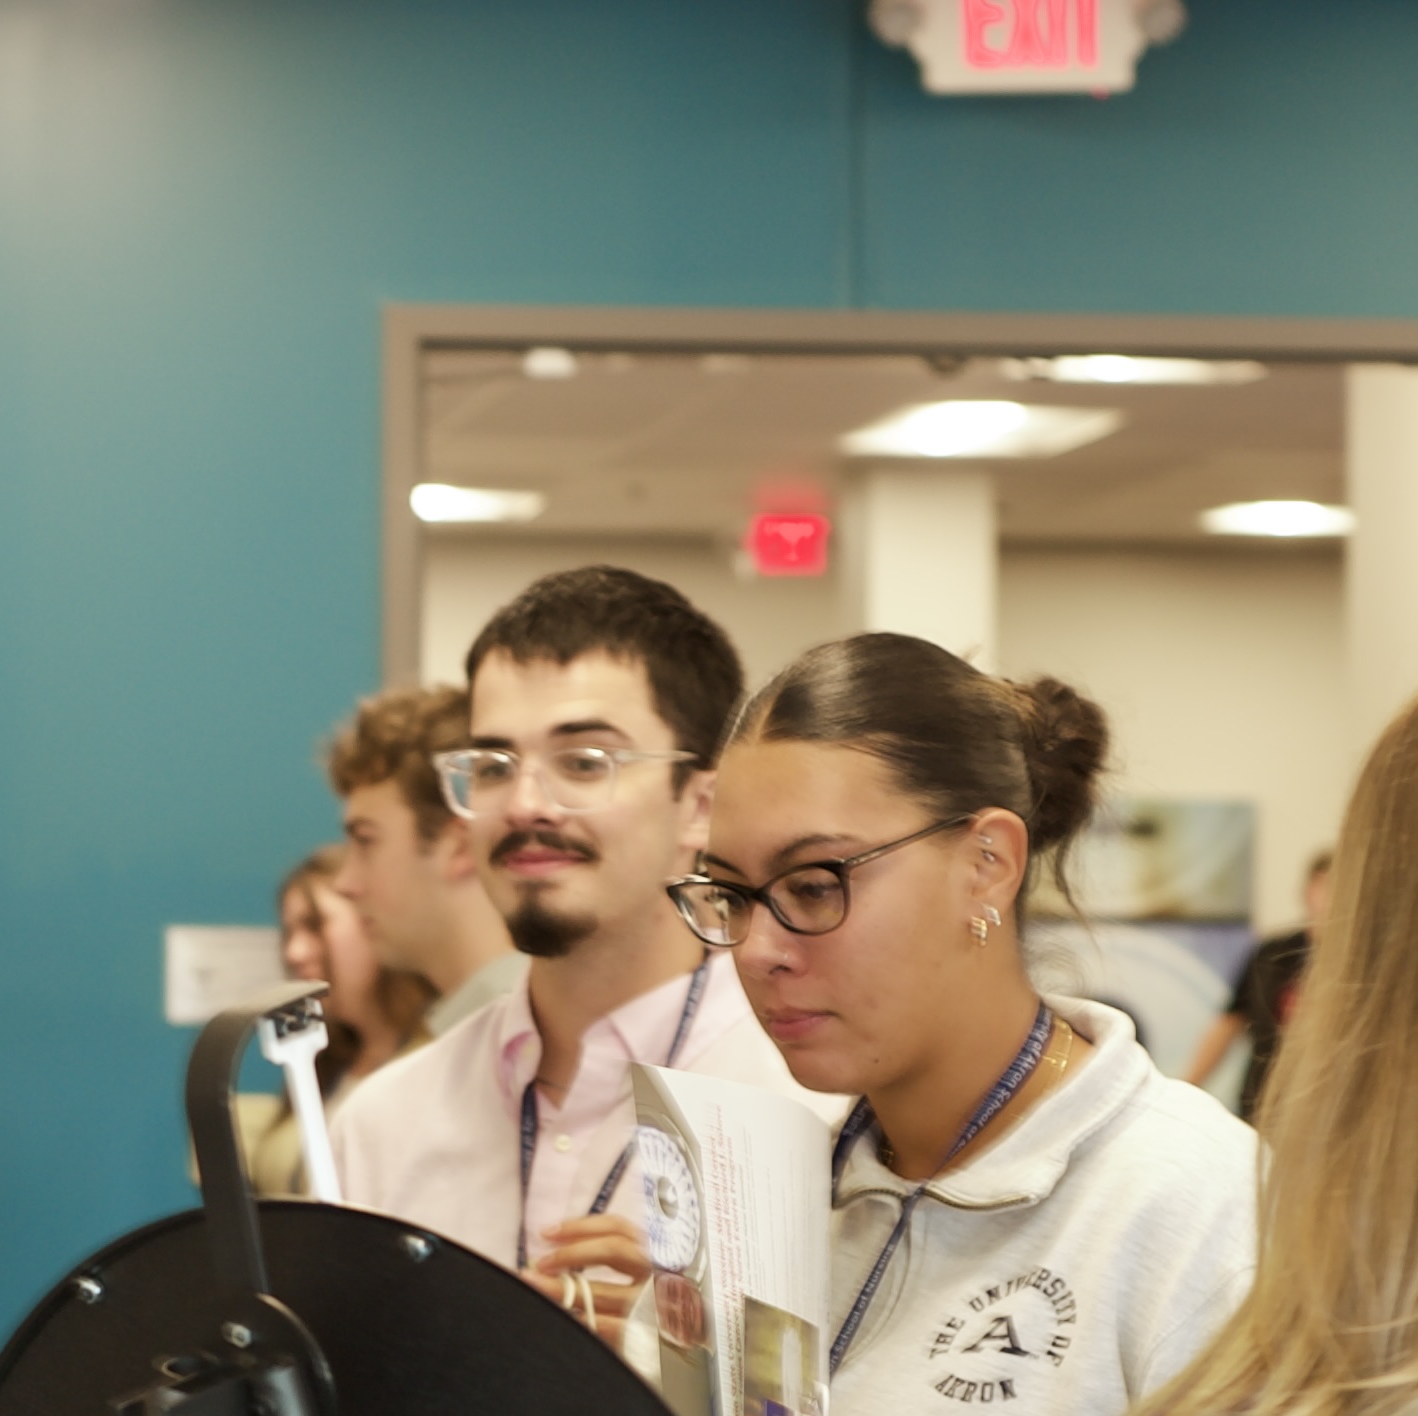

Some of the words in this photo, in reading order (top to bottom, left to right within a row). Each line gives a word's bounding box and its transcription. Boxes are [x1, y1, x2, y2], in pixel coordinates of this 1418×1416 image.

[1004, 1051, 1037, 1091] Akron
[976, 1084, 1012, 1130] School
[831, 1309, 862, 1354] School
[929, 1317, 965, 1360] THE
[1046, 1335, 1073, 1368] OF
[960, 1315, 1032, 1357] A
[934, 1374, 1018, 1403] AKRON
